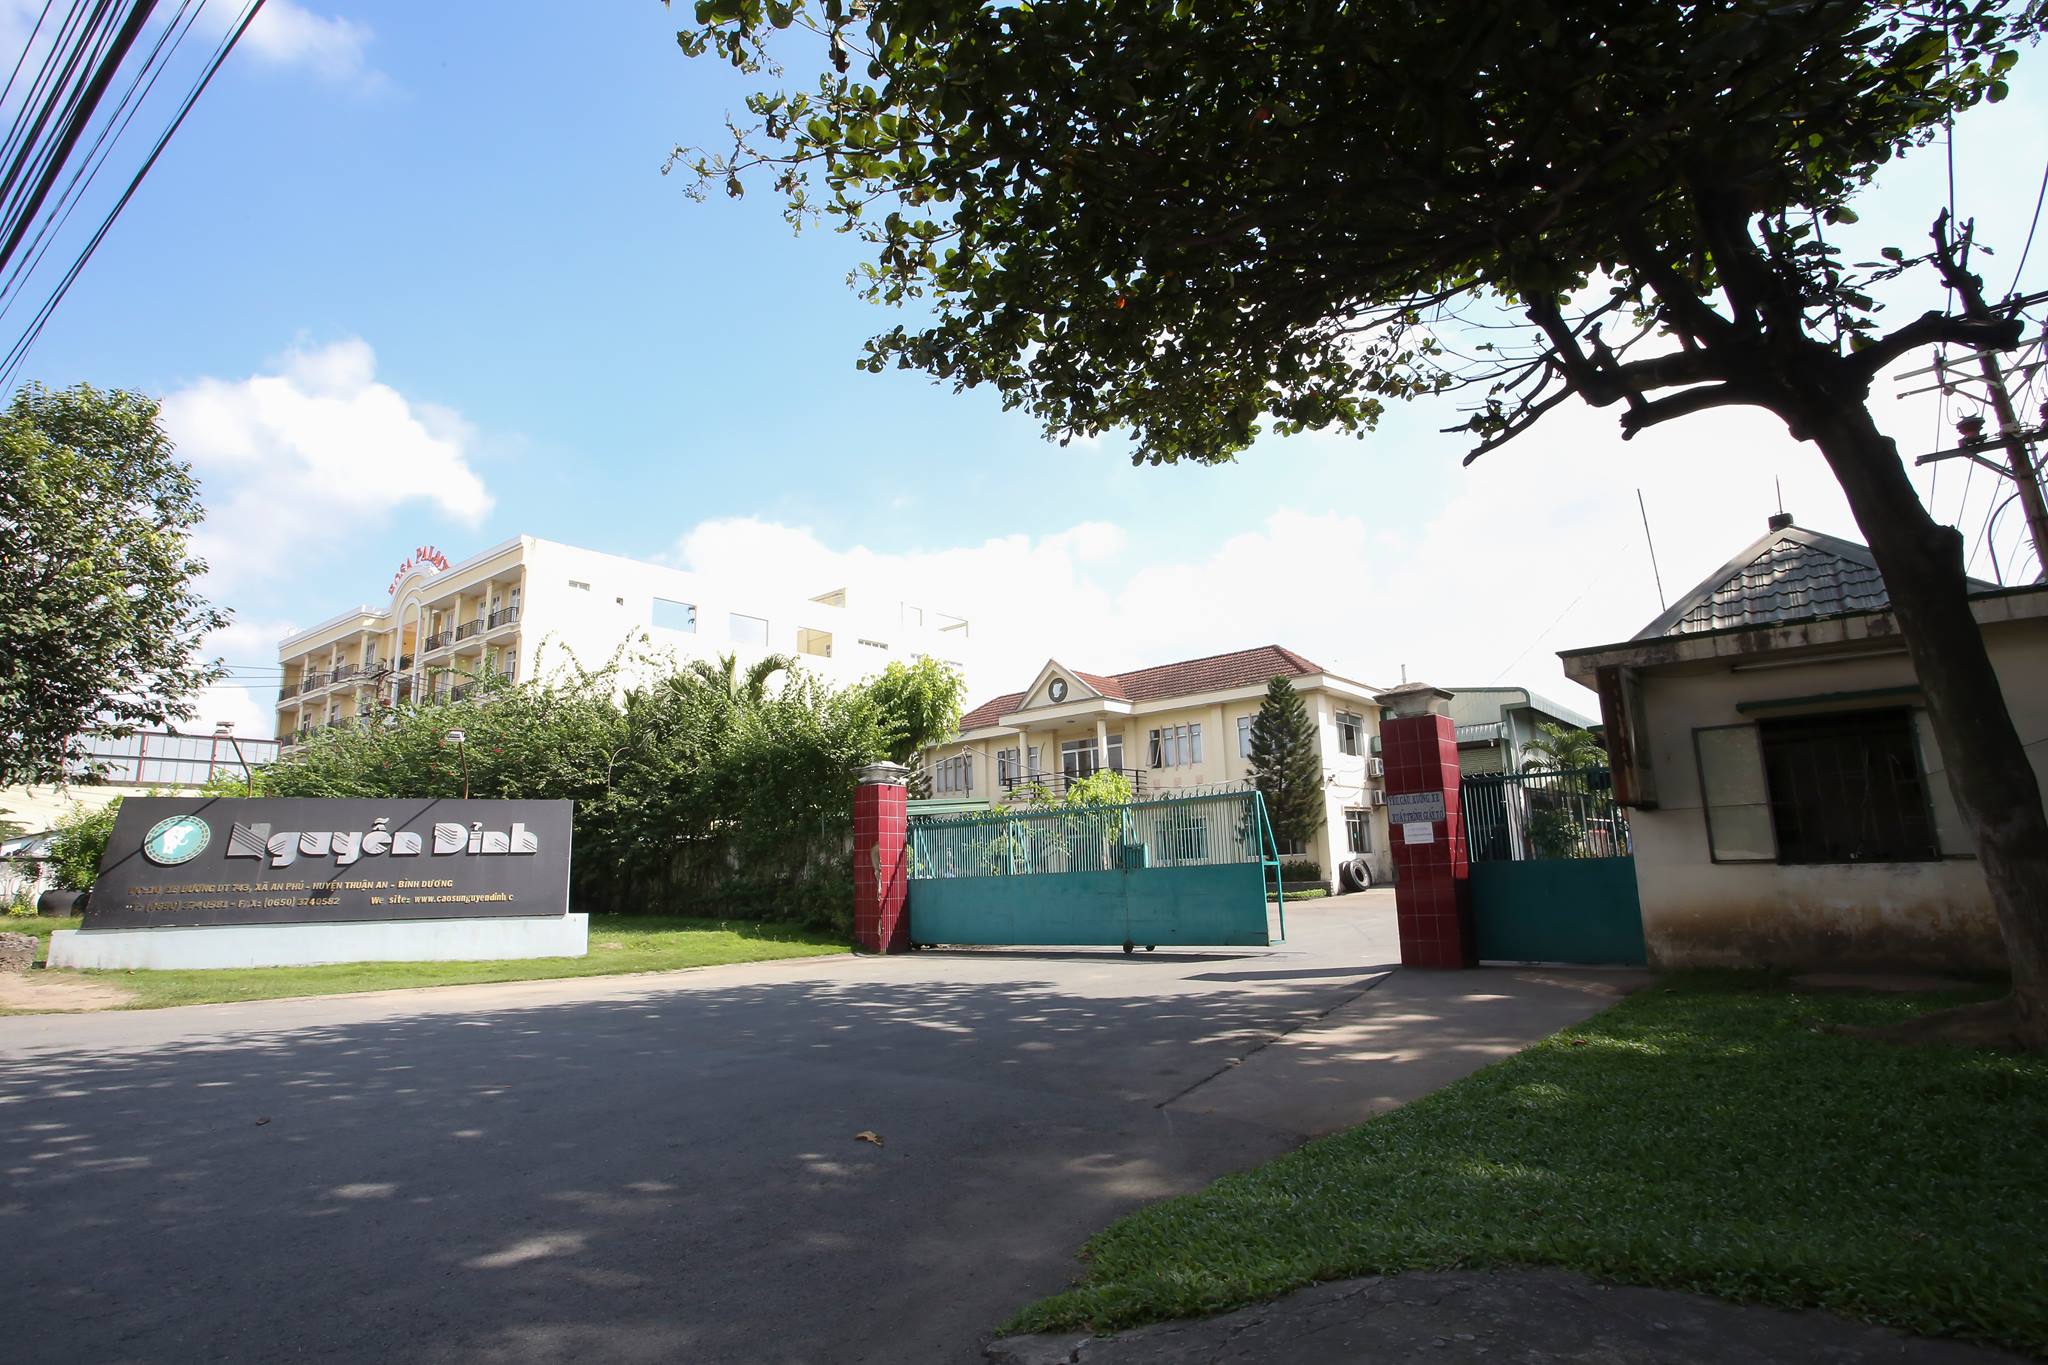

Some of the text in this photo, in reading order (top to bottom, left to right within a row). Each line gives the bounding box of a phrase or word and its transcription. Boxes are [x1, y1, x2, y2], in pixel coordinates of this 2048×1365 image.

[226, 817, 422, 867] Nguyễn
[255, 880, 268, 891] XÃ
[270, 883, 284, 891] AN
[286, 880, 304, 891] PHÚ
[312, 879, 343, 892] HUYỆN
[344, 879, 374, 892] THUẬN
[375, 881, 388, 889] AN
[398, 878, 419, 889] BÌNH
[421, 879, 453, 888] DƯƠNG
[263, 897, 295, 909] (0650)
[297, 897, 341, 907] 3740582
